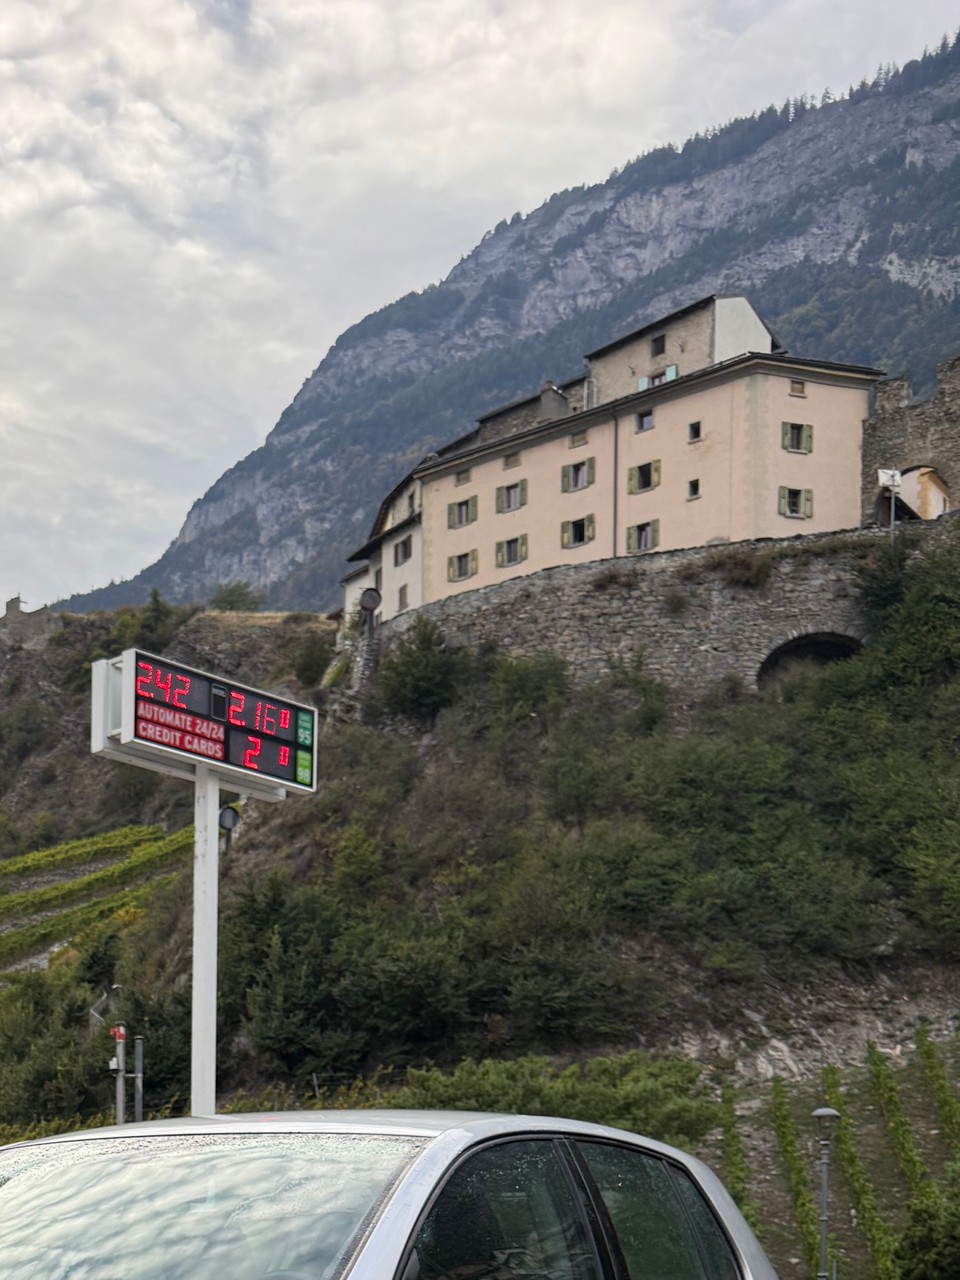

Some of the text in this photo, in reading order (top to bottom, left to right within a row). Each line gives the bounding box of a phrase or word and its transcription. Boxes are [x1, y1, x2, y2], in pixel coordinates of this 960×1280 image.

[138, 702, 224, 740] AUTOMATE 24/24
[139, 722, 222, 758] CREDIT CARDS
[298, 729, 311, 746] 95
[297, 767, 311, 783] 98
